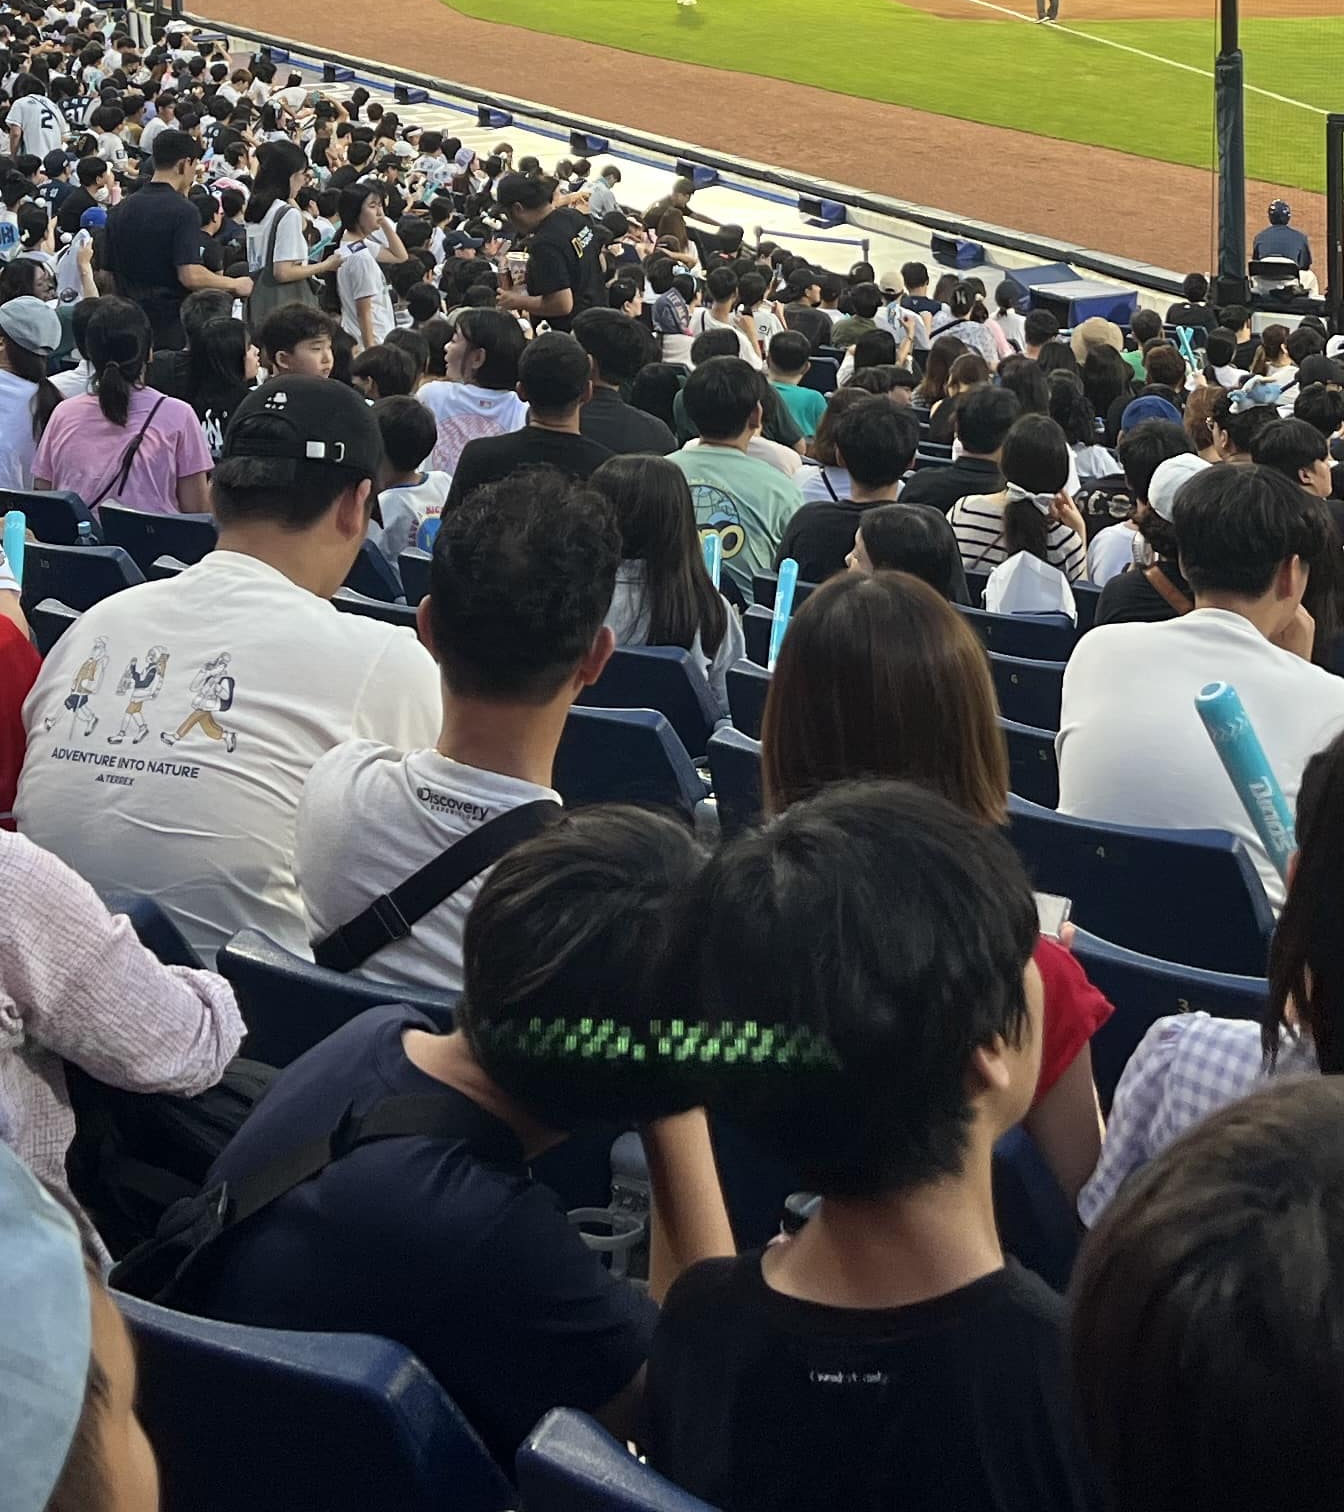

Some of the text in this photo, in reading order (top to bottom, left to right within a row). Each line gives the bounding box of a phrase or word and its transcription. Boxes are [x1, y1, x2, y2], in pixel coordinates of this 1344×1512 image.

[41, 109, 54, 129] 2
[51, 746, 200, 780] ADVENTURE INTO NATURE
[106, 774, 135, 787] TERREX
[416, 786, 490, 822] Discovery
[1177, 997, 1190, 1013] 3
